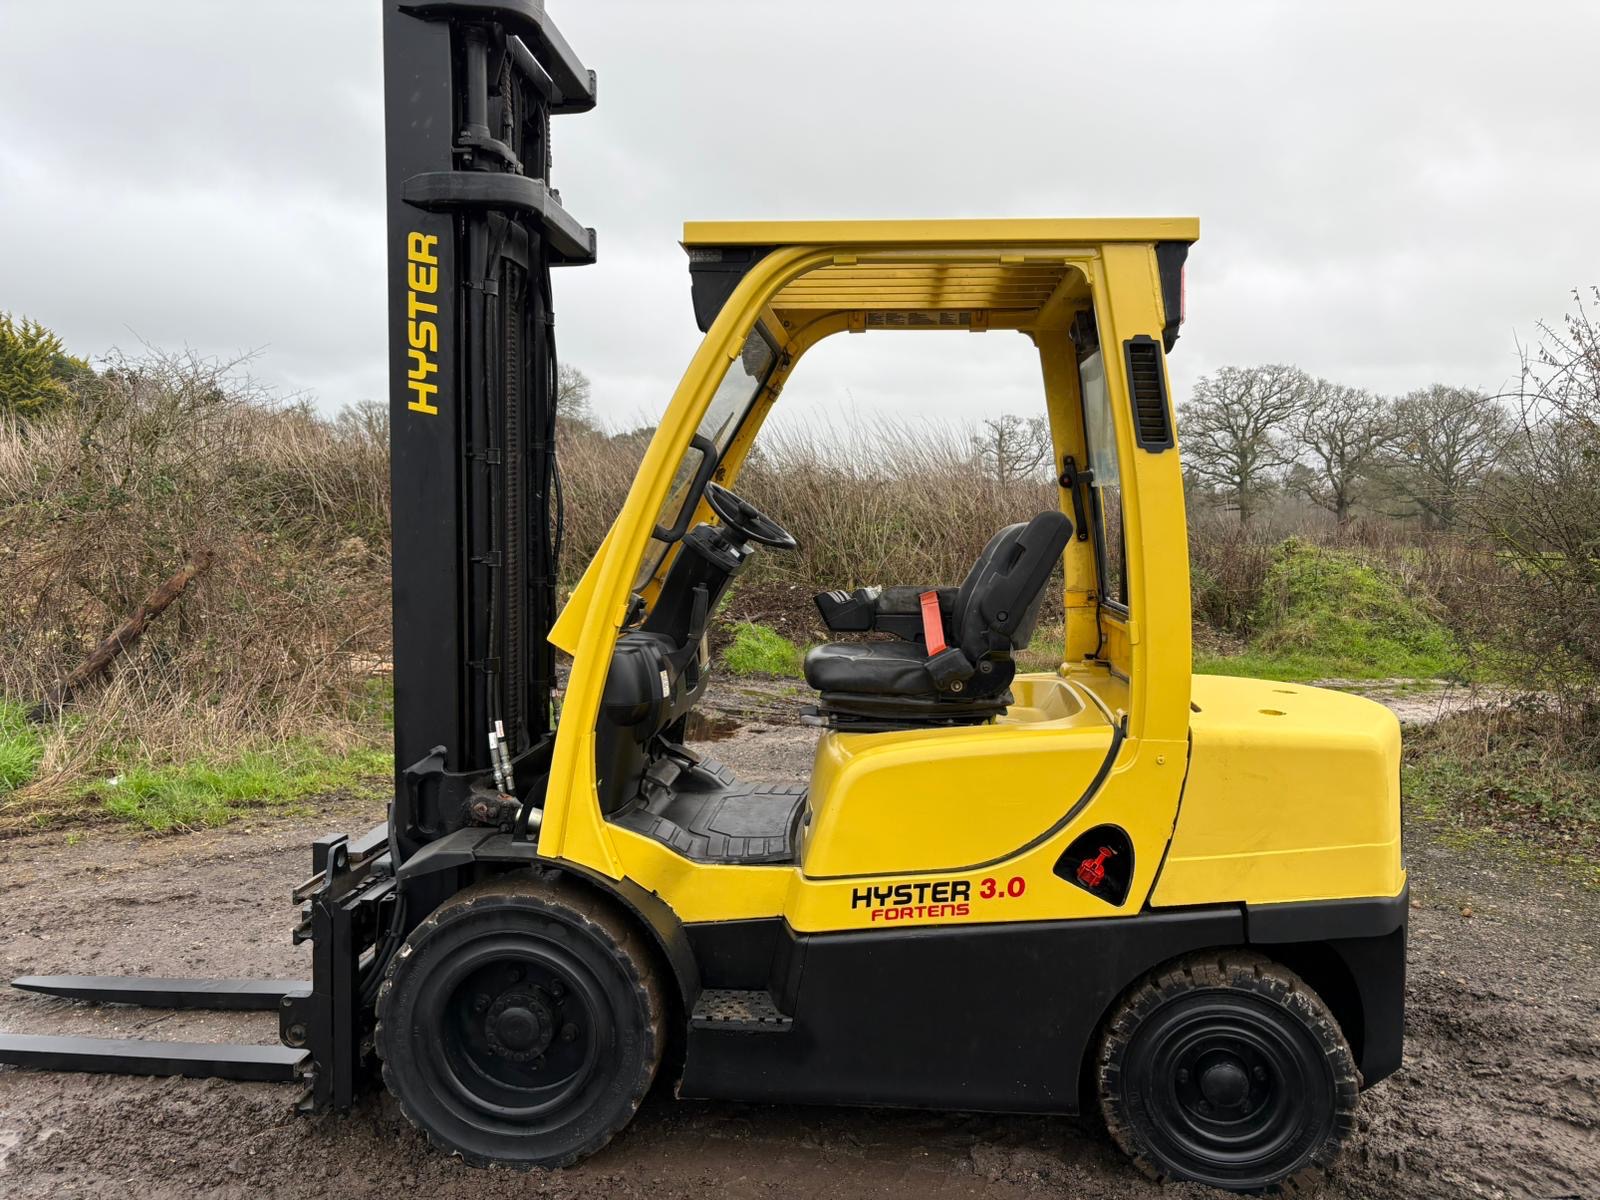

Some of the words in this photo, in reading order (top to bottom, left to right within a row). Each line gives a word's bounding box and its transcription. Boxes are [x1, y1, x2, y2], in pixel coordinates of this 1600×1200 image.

[408, 231, 438, 415] HYSTER
[852, 880, 971, 909] HYSTER
[979, 876, 1026, 899] 3.0
[871, 903, 970, 921] FORTENS
